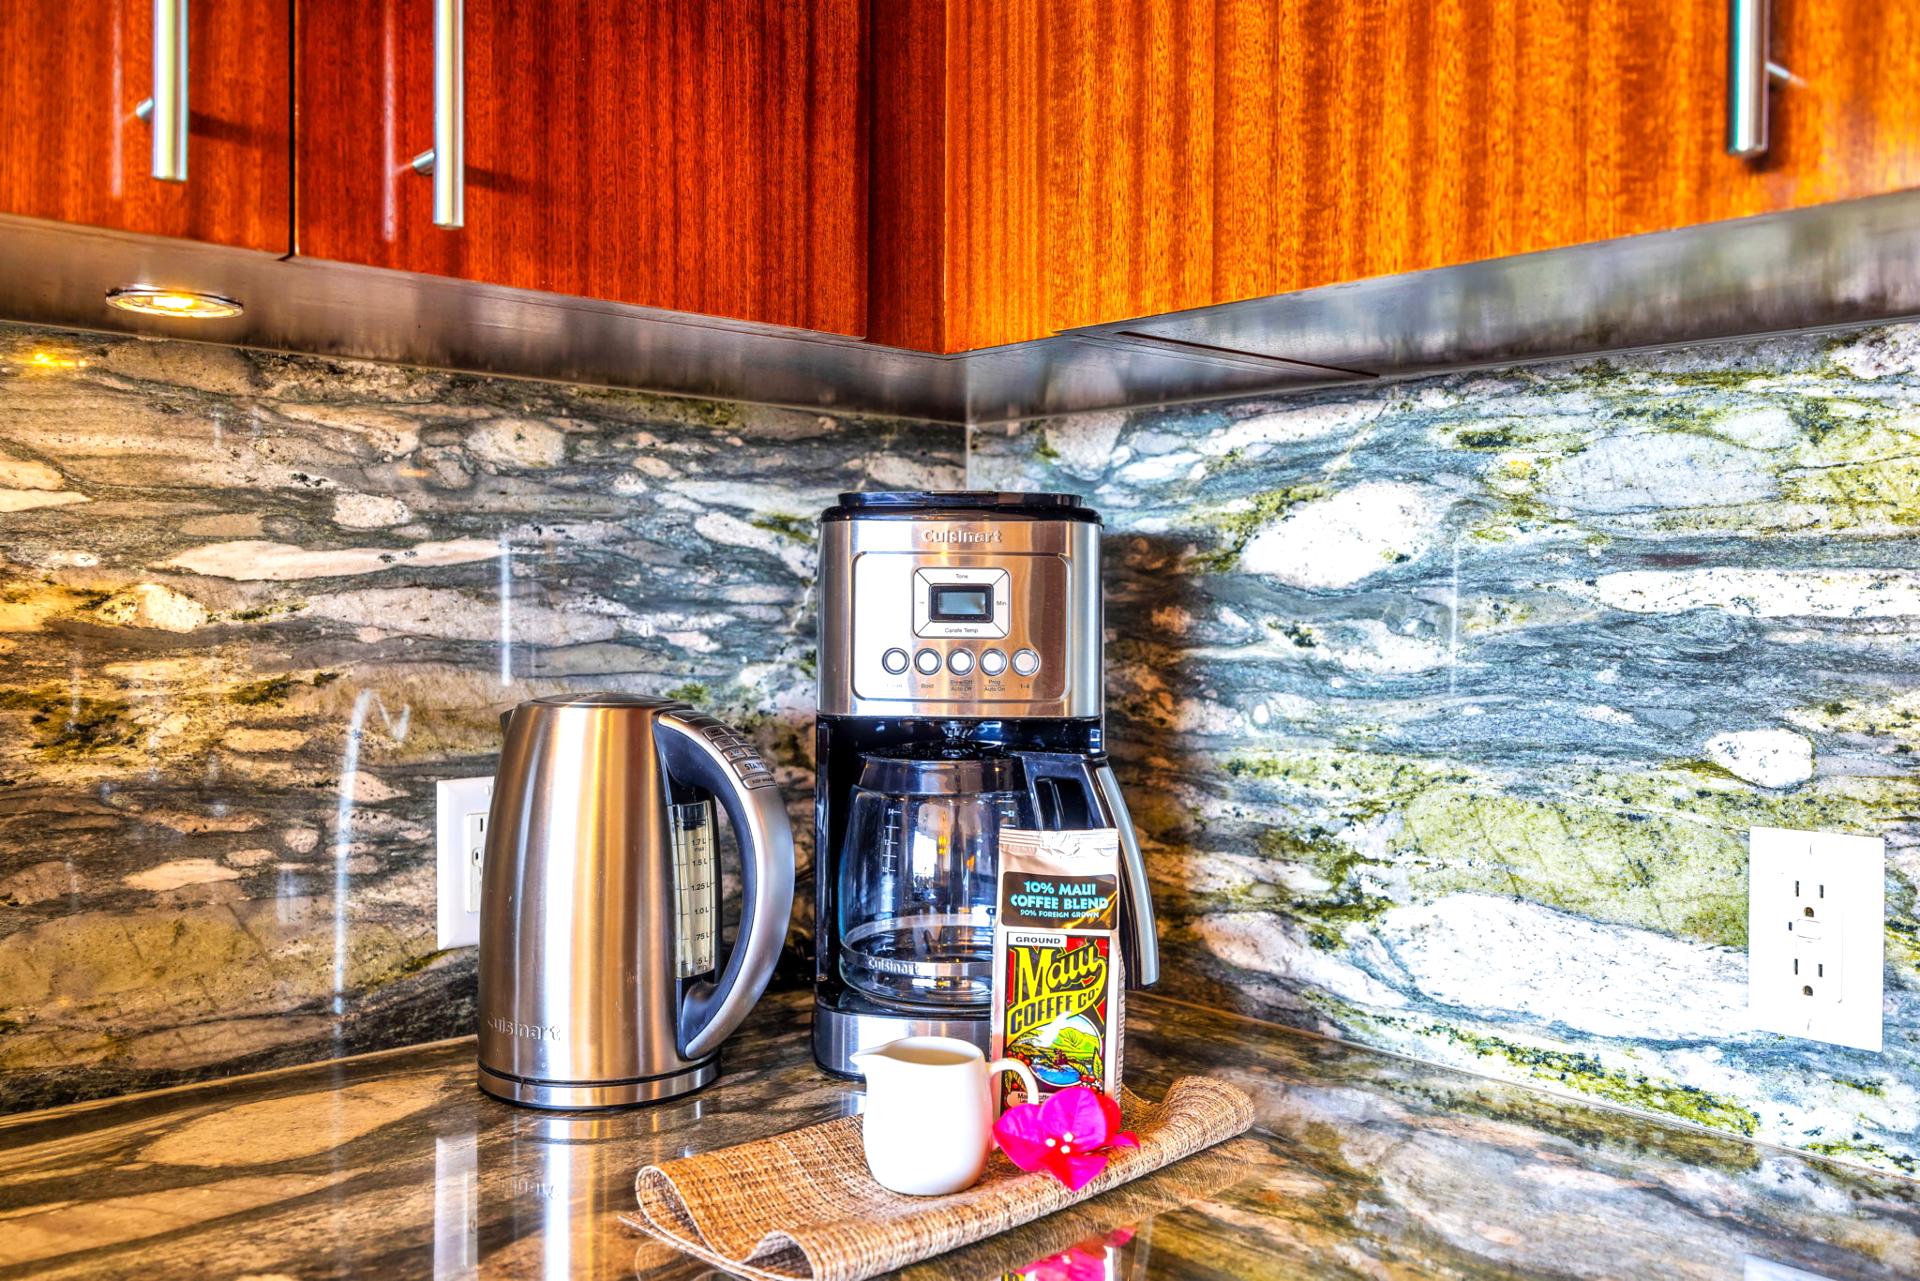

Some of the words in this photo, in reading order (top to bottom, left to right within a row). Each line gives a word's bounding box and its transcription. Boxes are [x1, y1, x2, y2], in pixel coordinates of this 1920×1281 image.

[921, 529, 1003, 544] Cuisinart
[692, 859, 703, 867] 1.5
[691, 883, 706, 892] 1.25
[1023, 881, 1054, 894] 10%
[1058, 883, 1097, 896] MAUI
[1010, 894, 1059, 910] COFFEE
[1063, 897, 1109, 911] BLEND
[694, 907, 704, 915] 1.0
[1038, 910, 1070, 919] FOREIGN
[1071, 911, 1100, 919] GROWN
[1015, 936, 1061, 945] GROUND
[1014, 945, 1106, 1005] Maui
[1010, 995, 1073, 1035] COFFEE
